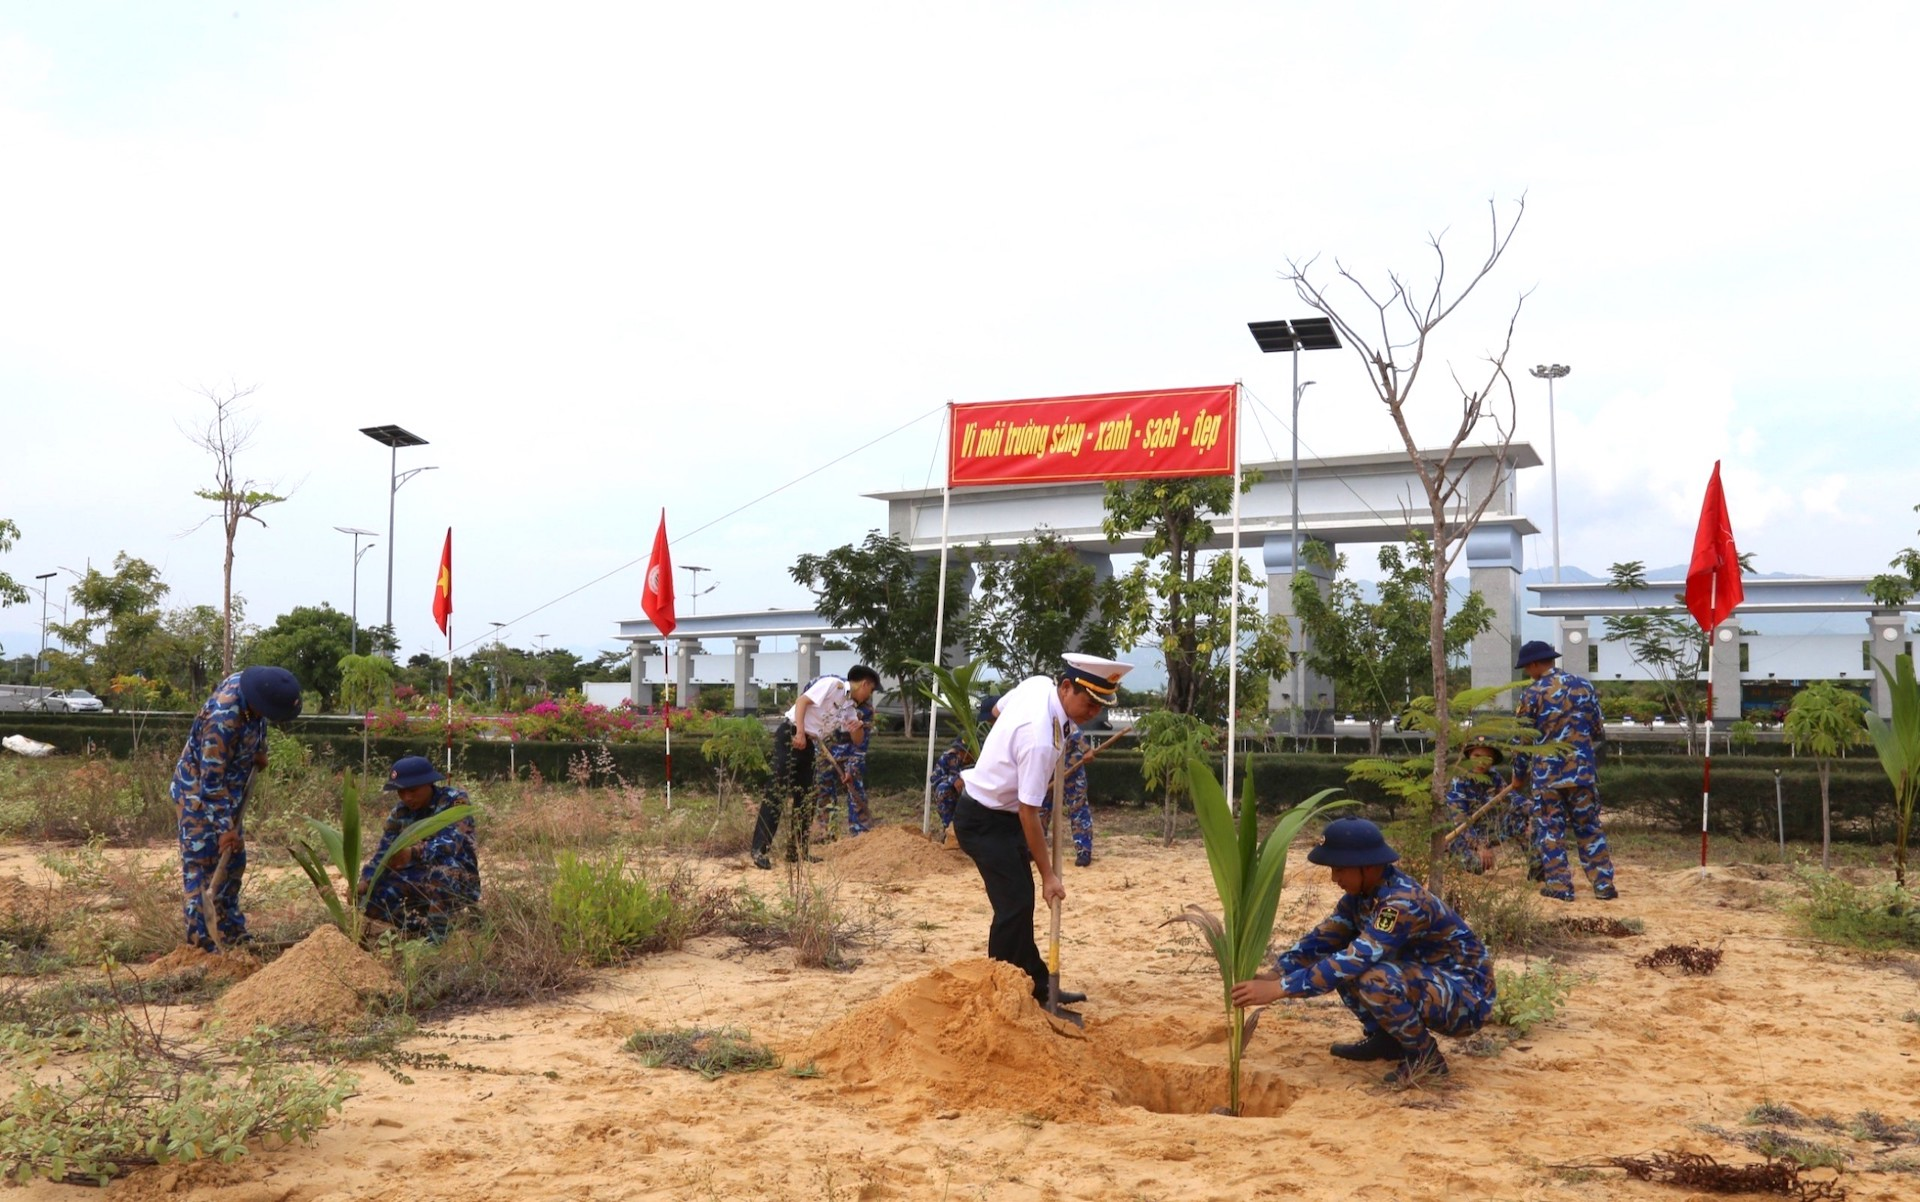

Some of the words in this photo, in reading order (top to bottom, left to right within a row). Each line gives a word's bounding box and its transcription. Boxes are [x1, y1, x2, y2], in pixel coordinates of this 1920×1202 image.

[961, 422, 978, 458] Vì
[975, 420, 1007, 458] môi
[1003, 418, 1051, 459] trường
[1049, 416, 1087, 458] sáng
[1087, 432, 1094, 440] -
[1093, 412, 1133, 451] xanh
[1134, 429, 1141, 438] -
[1142, 410, 1181, 457] sạch
[1182, 426, 1189, 435] -
[1190, 408, 1222, 455] đẹp
